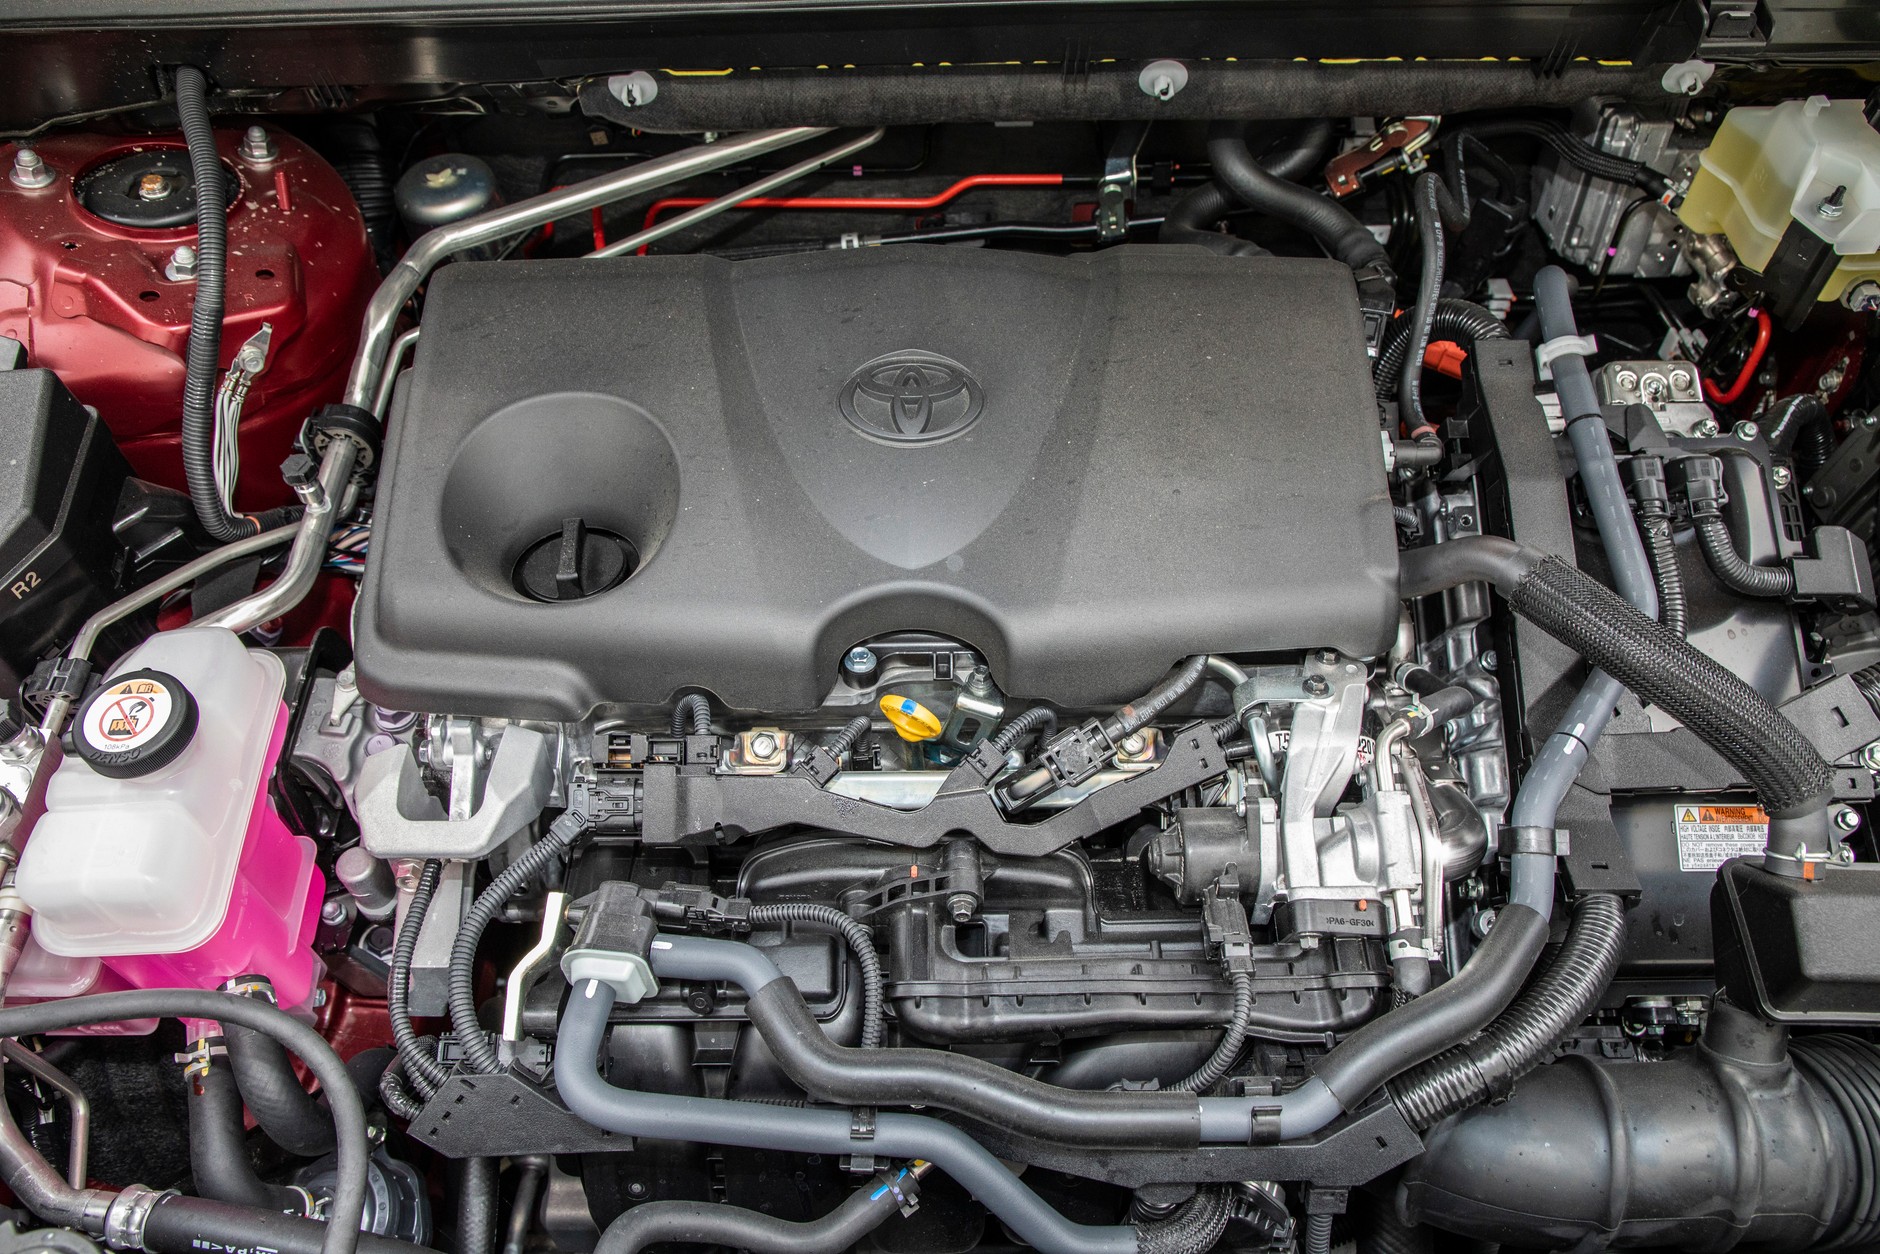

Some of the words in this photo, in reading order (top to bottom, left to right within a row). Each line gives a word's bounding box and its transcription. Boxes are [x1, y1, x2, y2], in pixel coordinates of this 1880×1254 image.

[10, 571, 42, 600] R2
[89, 748, 141, 765] DENSO
[1714, 807, 1746, 815] WARNING
